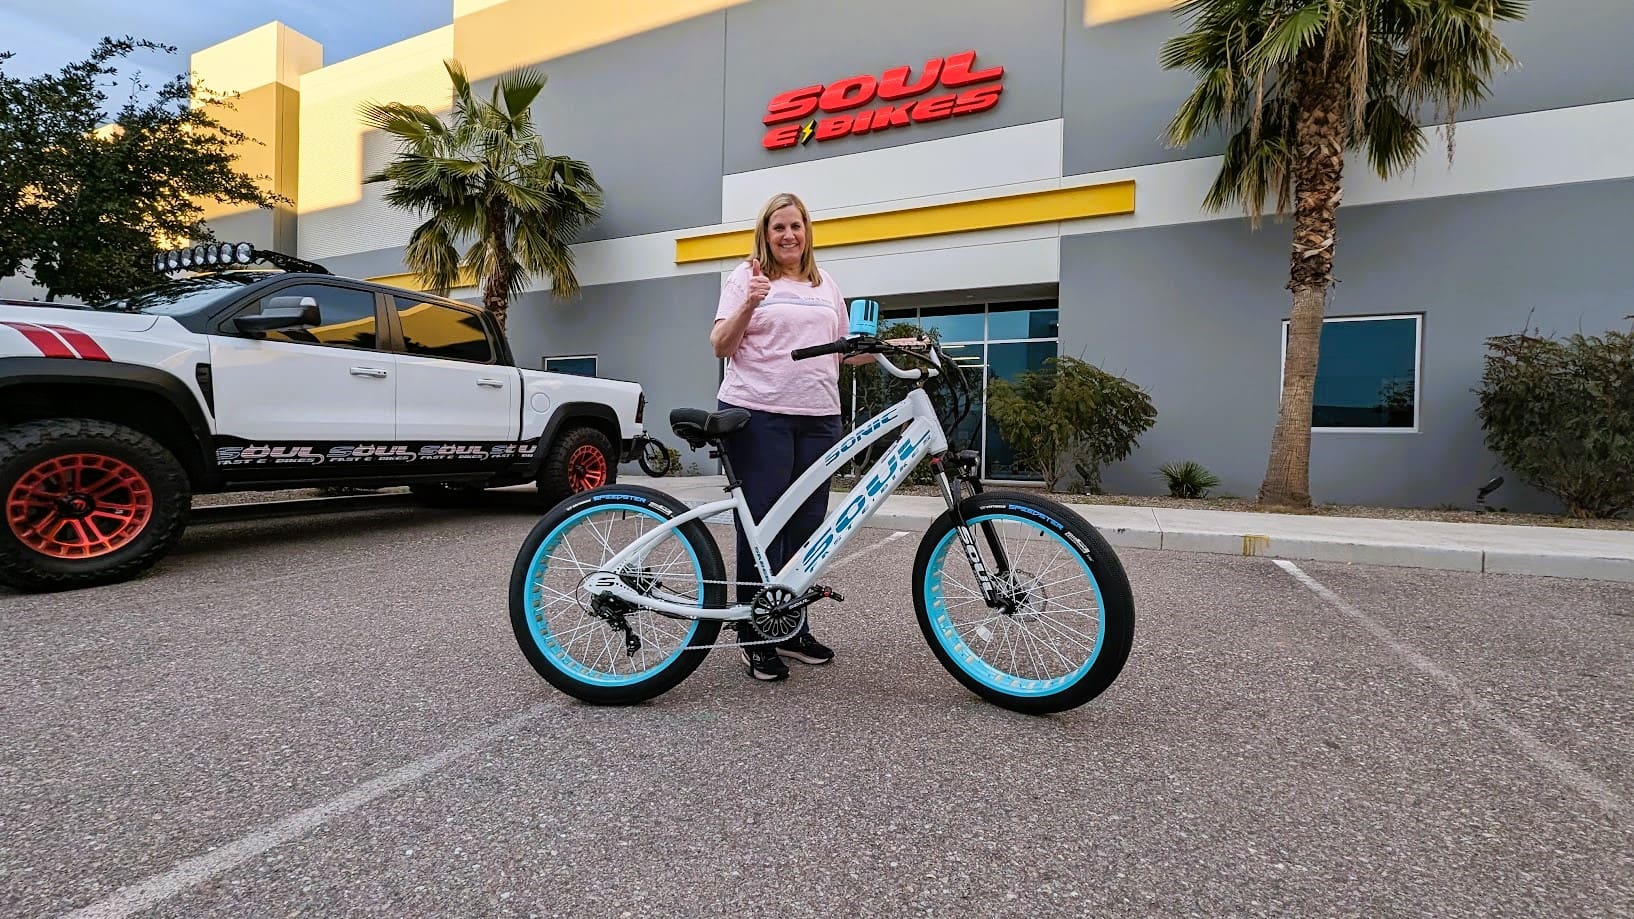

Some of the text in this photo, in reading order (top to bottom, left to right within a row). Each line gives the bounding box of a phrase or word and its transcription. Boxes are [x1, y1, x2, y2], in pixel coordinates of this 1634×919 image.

[763, 50, 1004, 126] SOUL
[418, 443, 489, 457] SOUL
[825, 408, 898, 467] SONIC
[215, 444, 324, 462] SOUL
[326, 444, 416, 460] SOUL
[592, 494, 647, 504] SPEEDSTER
[803, 429, 930, 573] SOUL
[1008, 504, 1064, 531] SPEEDSTER
[957, 526, 994, 601] SOUL
